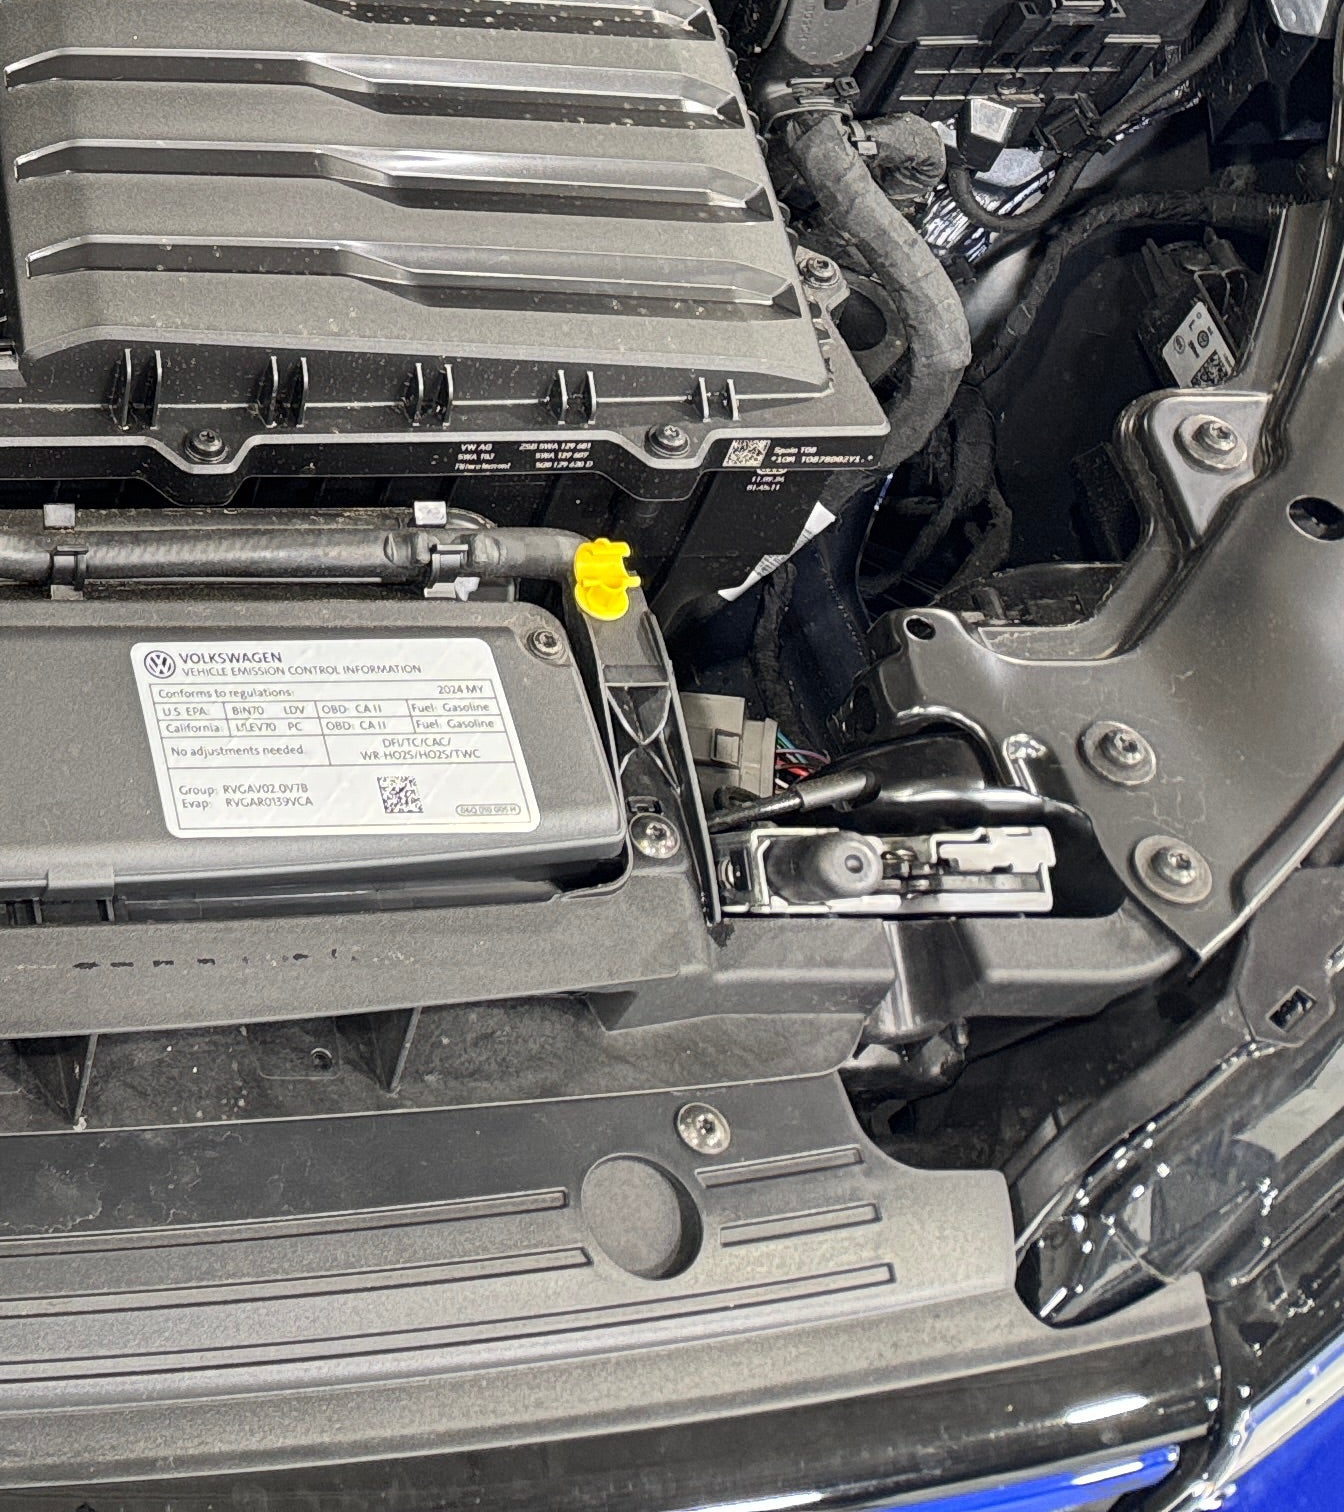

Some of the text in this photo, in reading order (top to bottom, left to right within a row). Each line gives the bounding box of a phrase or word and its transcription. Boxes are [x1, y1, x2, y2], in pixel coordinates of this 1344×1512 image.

[178, 651, 283, 664] VOLKSWAGEN
[181, 664, 422, 677] VEHICLE EMISSION CONTROL INFORMATION
[157, 688, 213, 698] Conforms
[213, 688, 227, 698] to
[436, 684, 485, 694] 2024 MY
[231, 705, 265, 715] BIN70
[282, 705, 306, 715] LDV
[353, 703, 372, 713] CA
[441, 702, 490, 712] Gasoline
[286, 721, 303, 731] PC
[358, 720, 376, 730] CA
[445, 718, 495, 728] Gasoline
[170, 746, 260, 757] No adjustments
